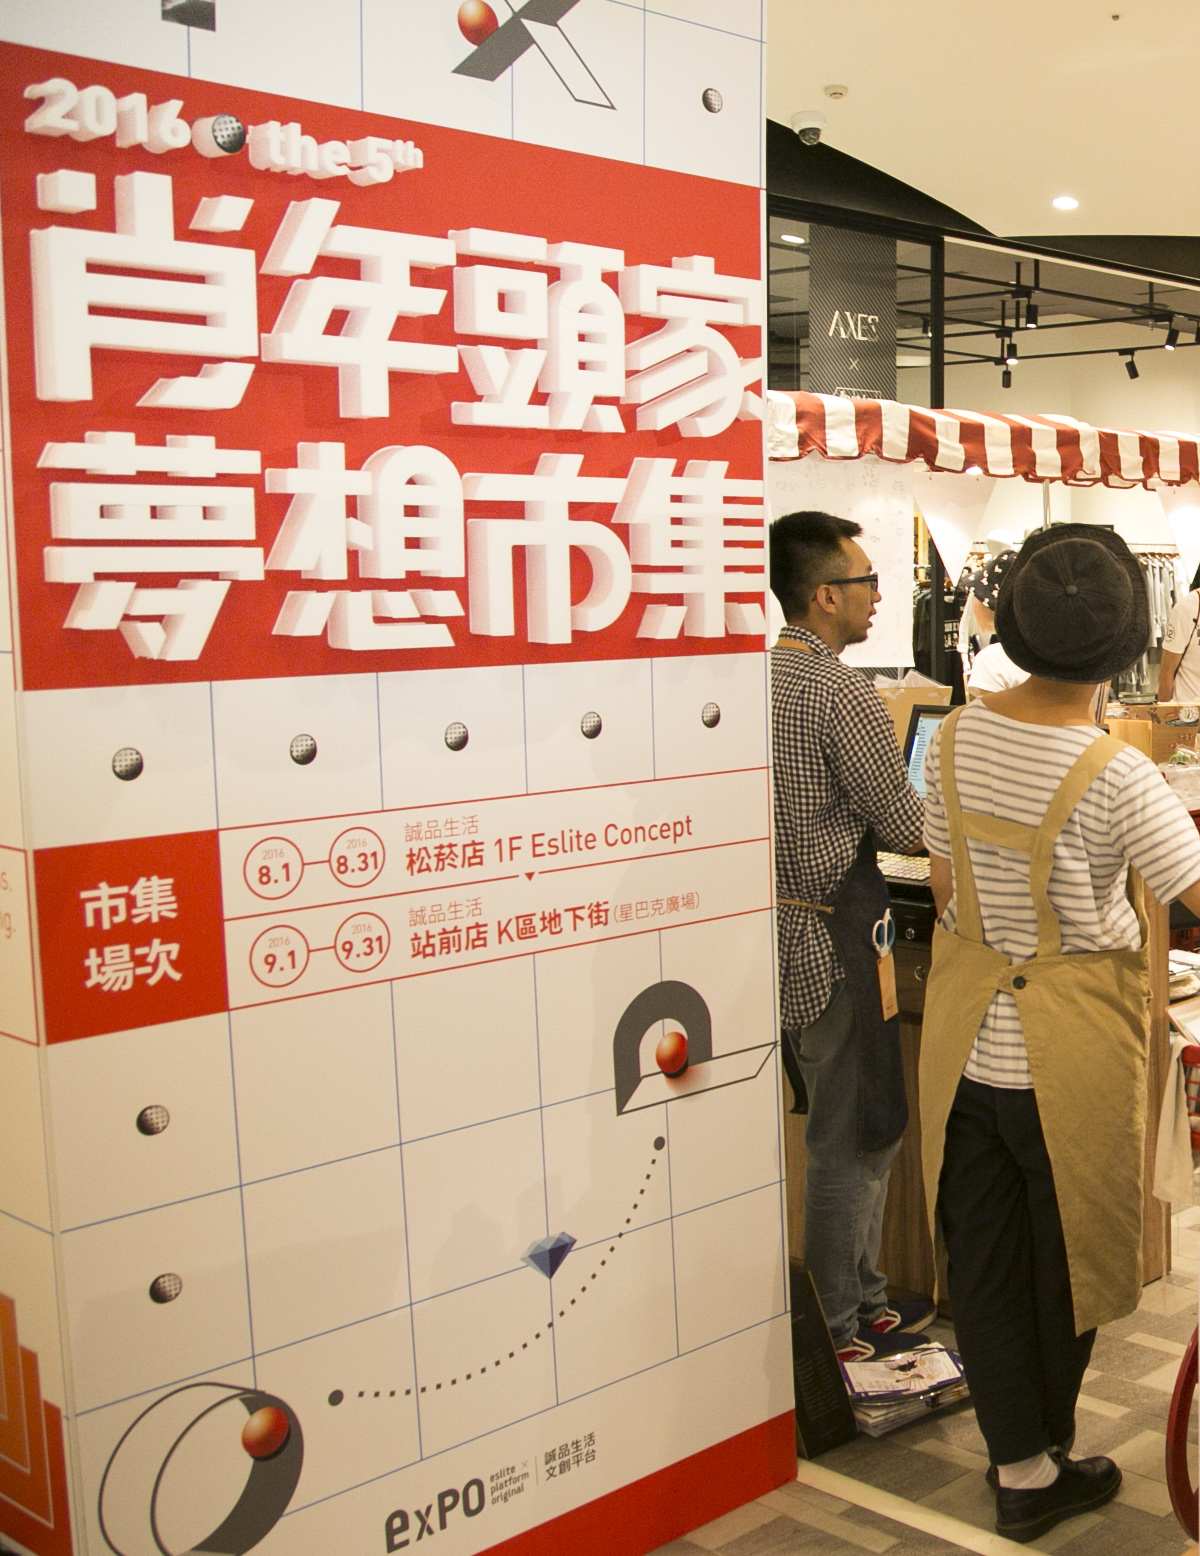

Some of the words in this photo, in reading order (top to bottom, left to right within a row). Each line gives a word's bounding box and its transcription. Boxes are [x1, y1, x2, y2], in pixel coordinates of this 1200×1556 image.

[24, 77, 192, 154] 2016
[247, 120, 351, 180] the
[347, 136, 424, 187] 5th
[36, 430, 767, 661] 夢想市集
[404, 814, 479, 843] 誠品生活
[262, 848, 285, 861] 2016
[346, 837, 368, 850] 2016
[405, 840, 485, 877] 松菸店
[494, 835, 524, 863] 1F
[531, 829, 598, 858] Eslite
[604, 815, 693, 848] Concept
[258, 862, 291, 886] 8.1
[336, 851, 379, 875] 8.31
[79, 875, 178, 930] 市集
[408, 896, 483, 927] 誠品生活
[351, 922, 373, 935] 2016
[410, 922, 489, 960] 站前店
[497, 900, 611, 945] K區地下街
[268, 936, 291, 948] 2016
[341, 935, 384, 961] 9.31
[84, 938, 183, 992] 場次
[263, 950, 297, 974] 9.1
[544, 1431, 597, 1466] 誠品生活
[489, 1465, 516, 1483] eslite
[545, 1449, 597, 1481] 文創平台
[490, 1471, 530, 1497] platform
[491, 1483, 525, 1506] original
